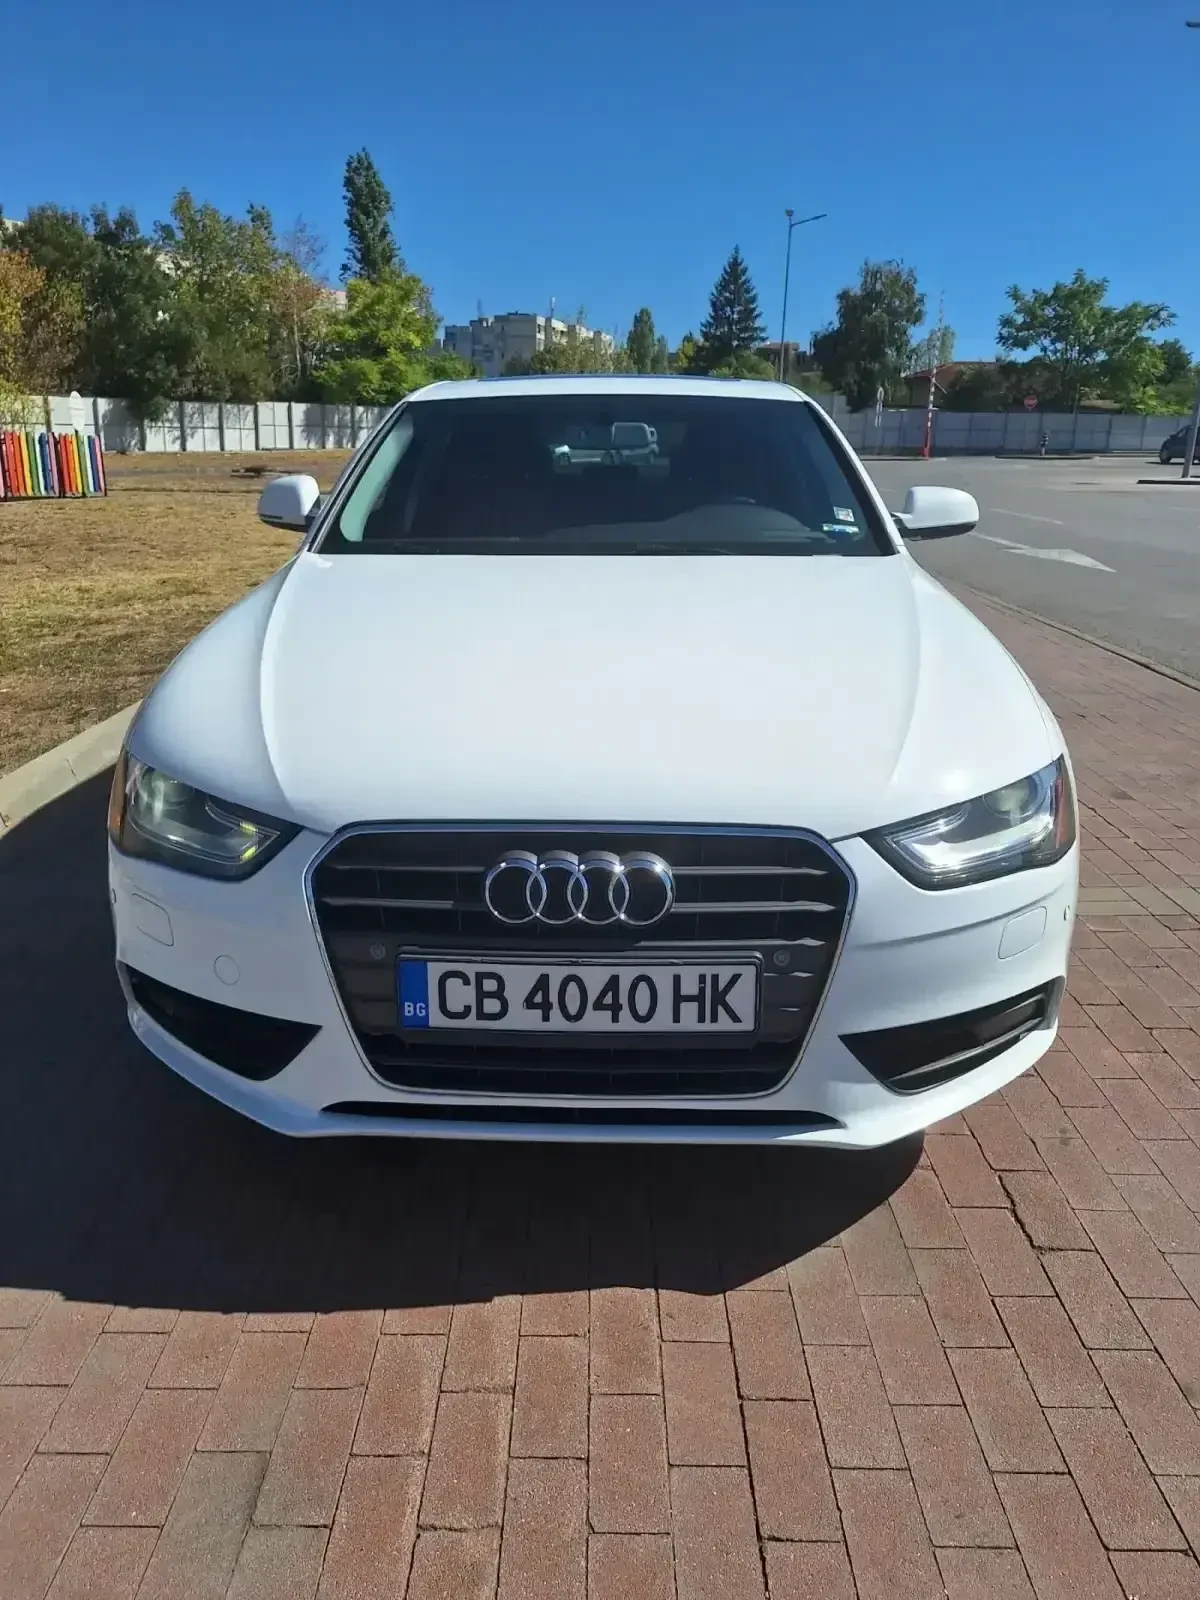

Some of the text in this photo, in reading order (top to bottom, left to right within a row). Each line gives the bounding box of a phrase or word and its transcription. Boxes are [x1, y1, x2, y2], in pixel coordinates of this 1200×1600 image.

[404, 1002, 426, 1017] BG
[437, 970, 743, 1024] CB 4040 HK
